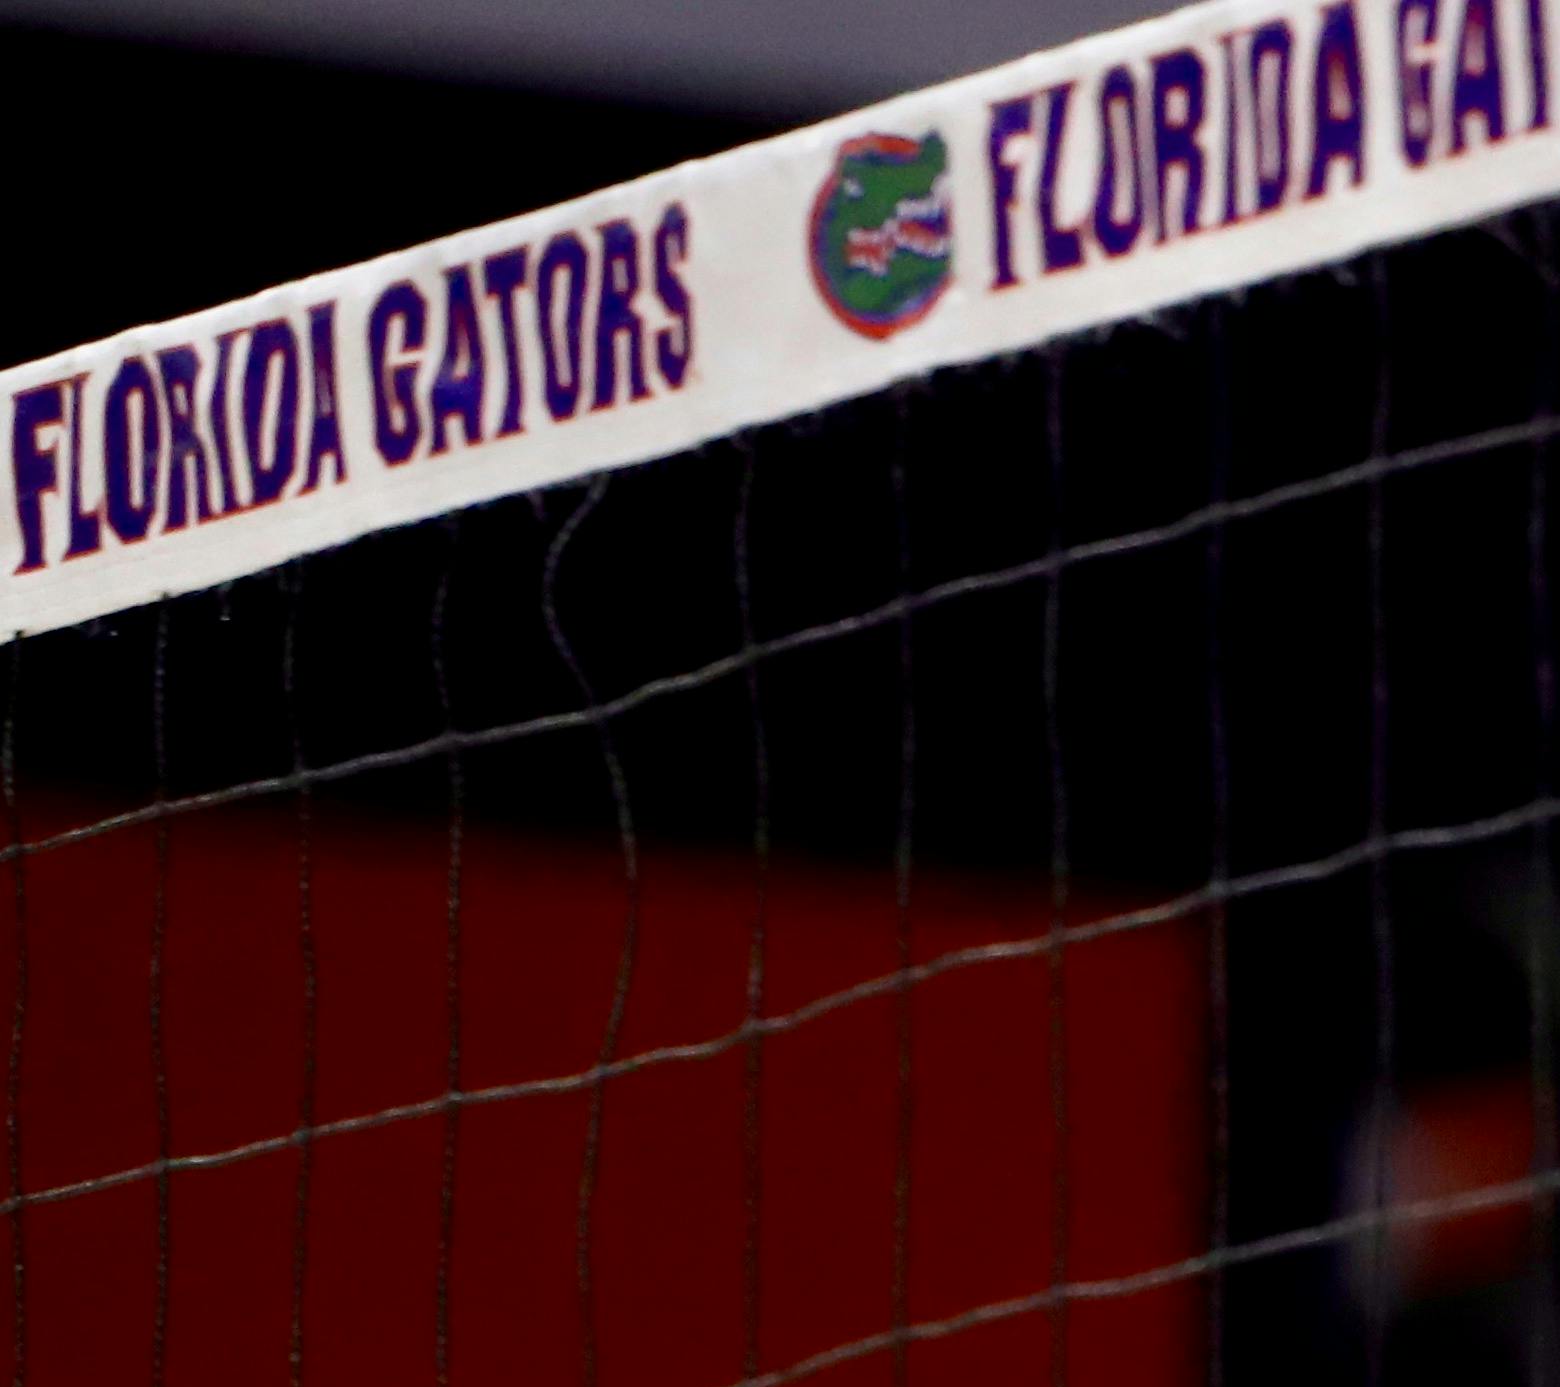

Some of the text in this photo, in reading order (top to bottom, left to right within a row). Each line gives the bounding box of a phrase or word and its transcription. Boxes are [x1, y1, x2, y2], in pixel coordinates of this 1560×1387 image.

[984, 1, 1370, 292] FLORIDA
[12, 200, 695, 575] FLORIDA GATORS
